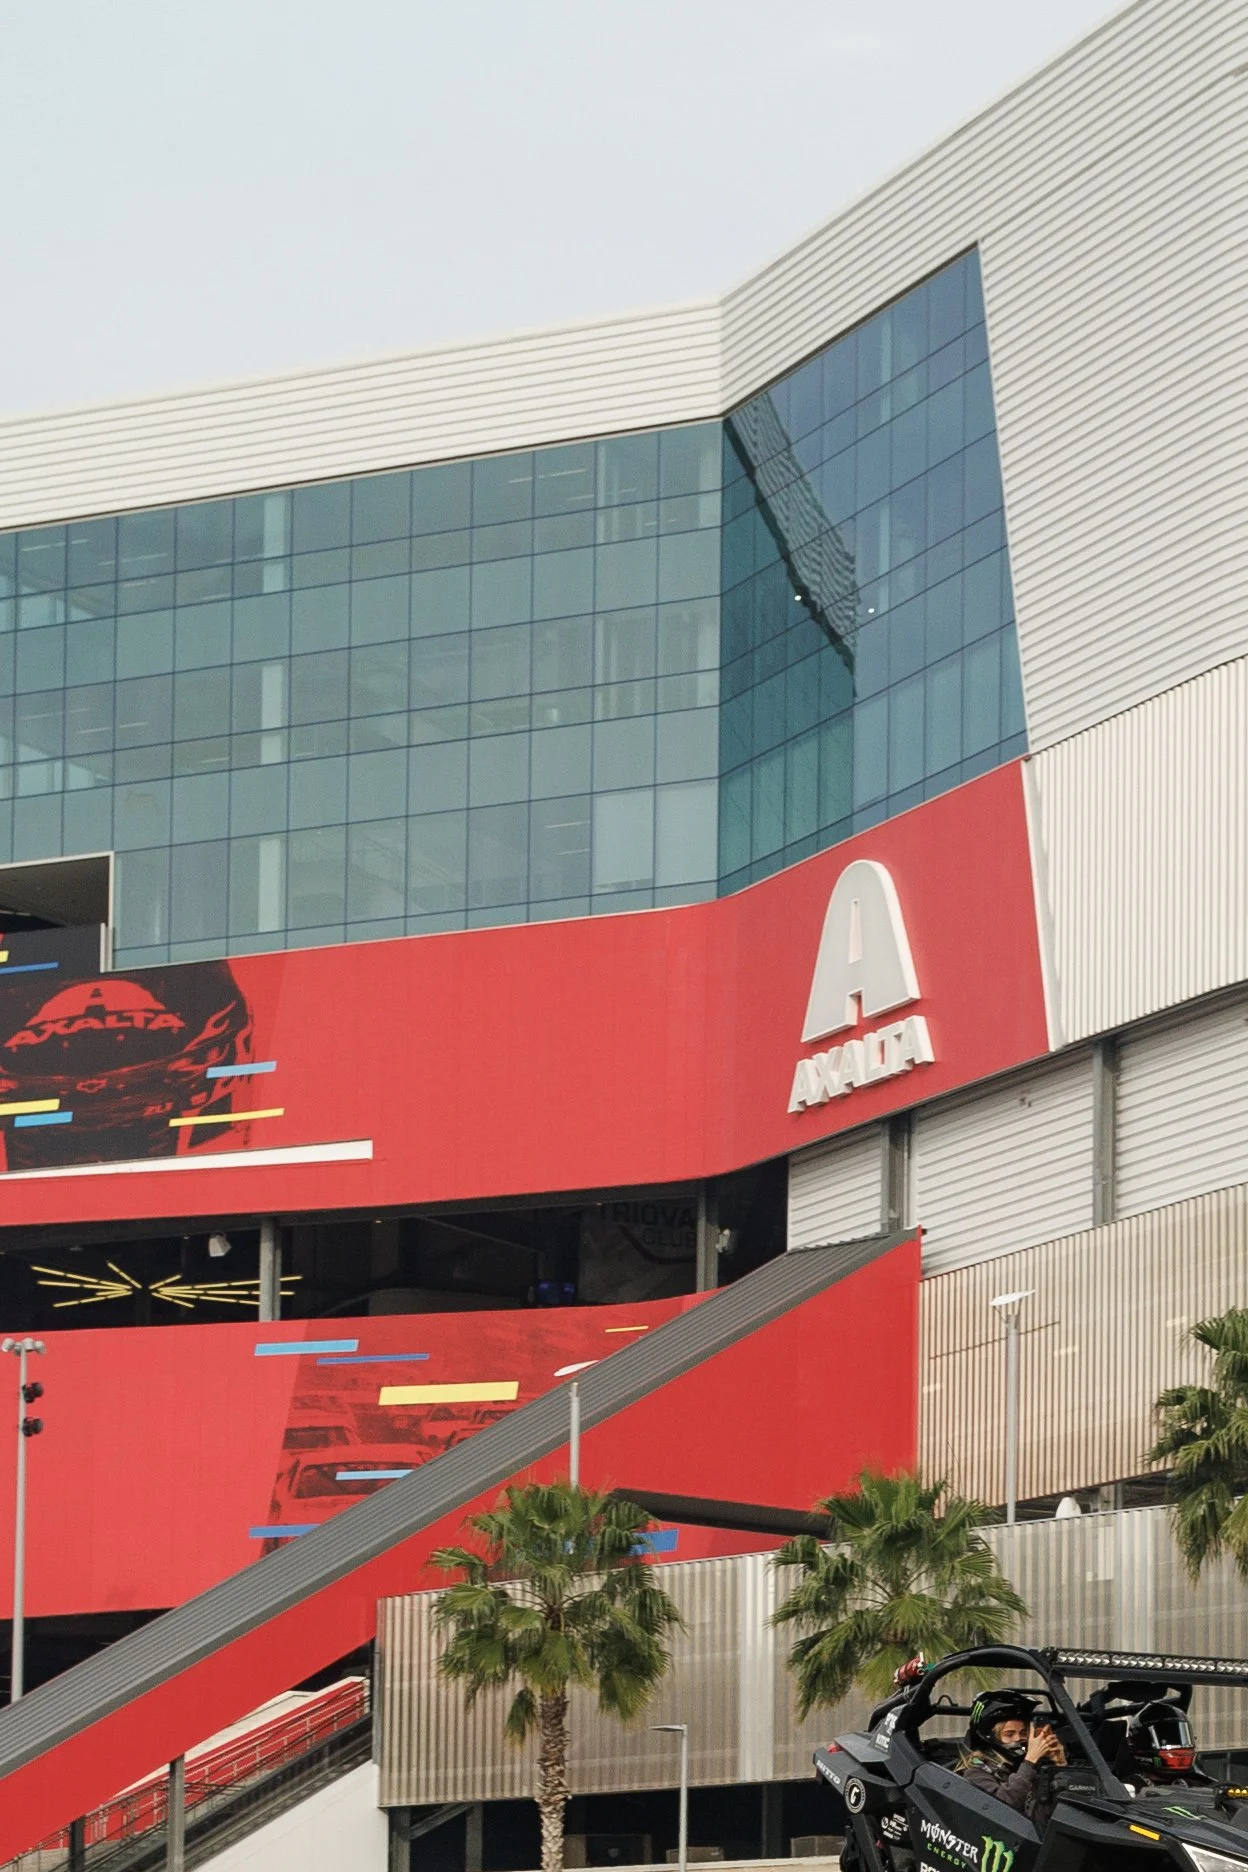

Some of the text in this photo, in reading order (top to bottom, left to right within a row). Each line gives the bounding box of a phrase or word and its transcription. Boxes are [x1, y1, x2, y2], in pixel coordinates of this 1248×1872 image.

[4, 1011, 186, 1051] AXALTA
[787, 1015, 935, 1113] AXALTA
[927, 1843, 967, 1869] ENERGY
